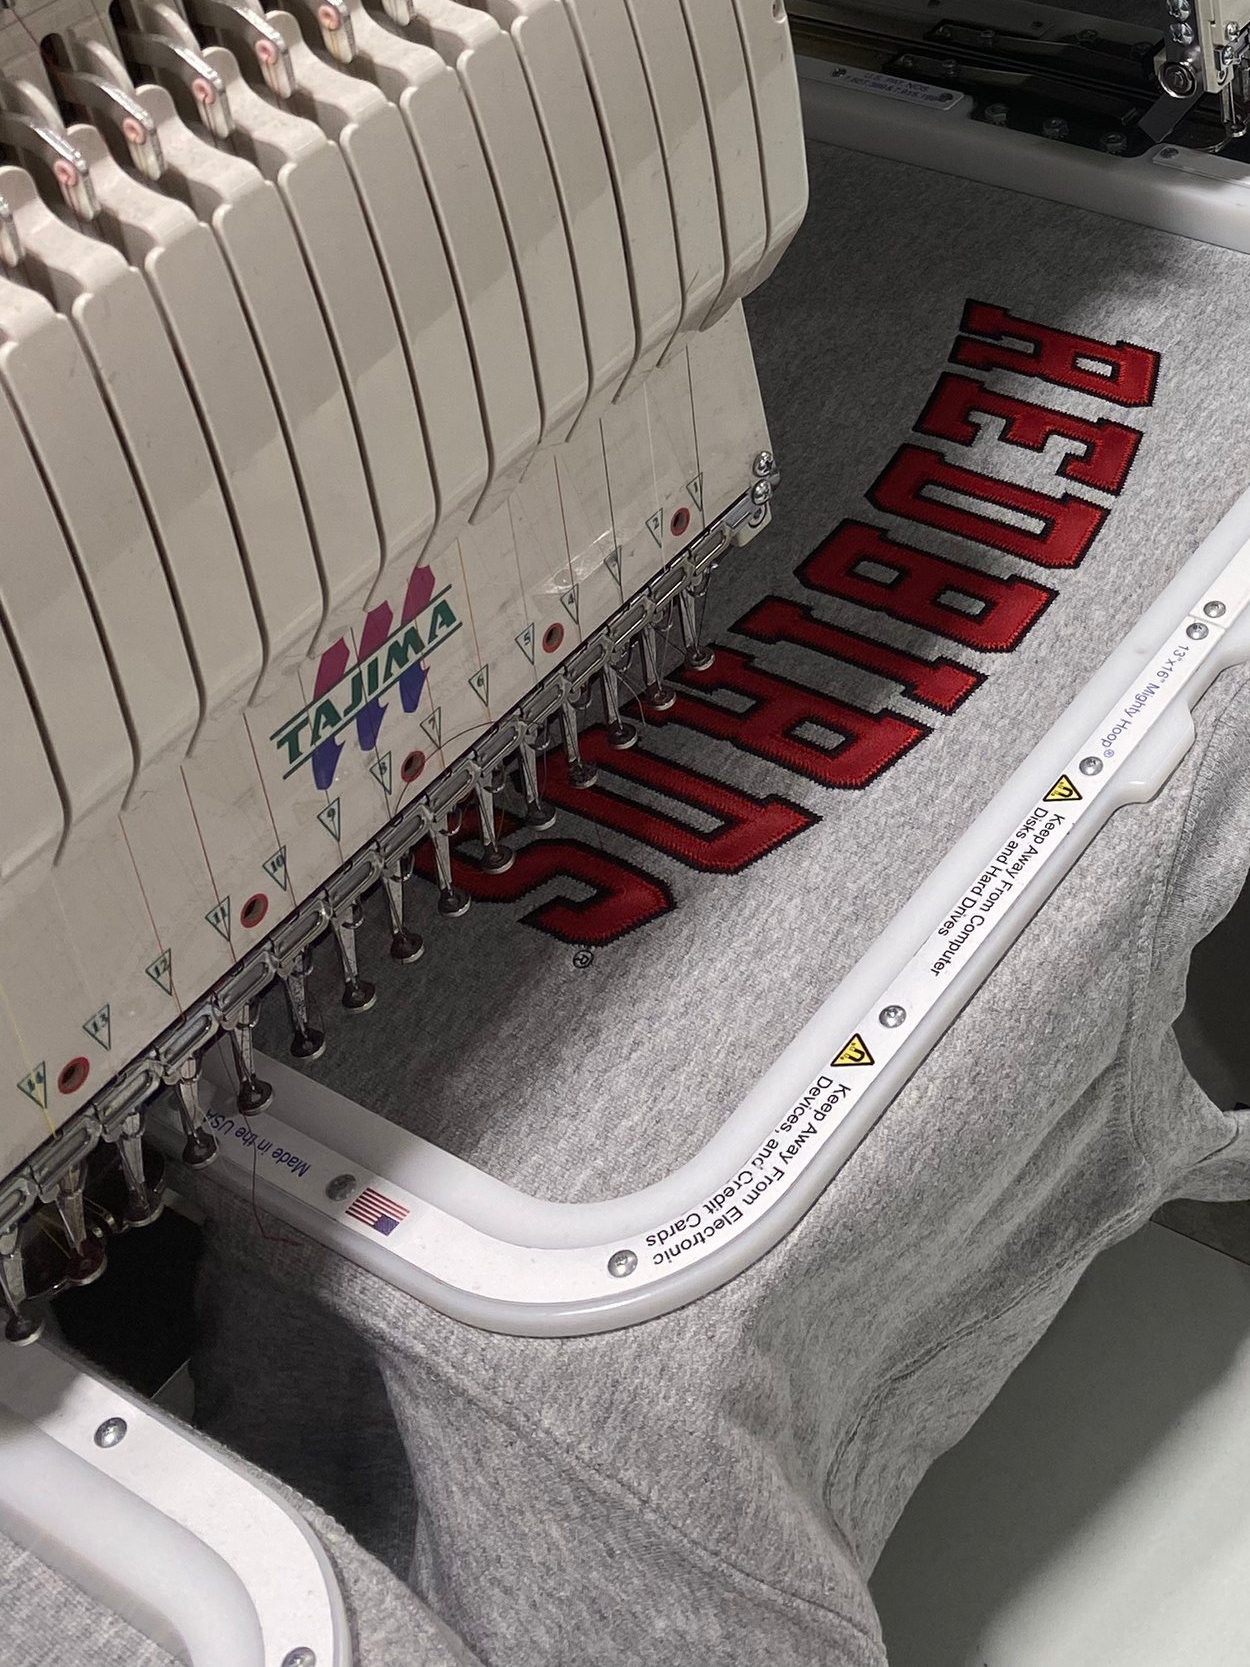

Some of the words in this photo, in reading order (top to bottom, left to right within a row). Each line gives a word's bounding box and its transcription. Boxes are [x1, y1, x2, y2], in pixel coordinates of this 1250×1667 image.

[277, 599, 457, 765] TAJIMA
[1124, 682, 1160, 718] Mighty
[1015, 807, 1048, 839] Disks
[1038, 813, 1065, 845] Keep
[996, 840, 1018, 865] and
[1006, 844, 1038, 879] Away
[970, 865, 1003, 897] Hard
[980, 879, 1013, 912] From
[937, 896, 977, 937] Drives
[930, 914, 985, 977] Computer
[775, 1075, 833, 1133] Devices,
[813, 1083, 851, 1122] Keep
[203, 1109, 234, 1135] USA
[235, 1127, 258, 1147] the
[257, 1139, 273, 1155] in
[751, 1138, 779, 1170] and
[779, 1121, 818, 1164] Away
[272, 1148, 311, 1177] Made
[702, 1170, 753, 1215] Credit
[742, 1166, 785, 1205] From
[646, 1212, 701, 1247] Cards
[653, 1205, 743, 1265] Electronic
